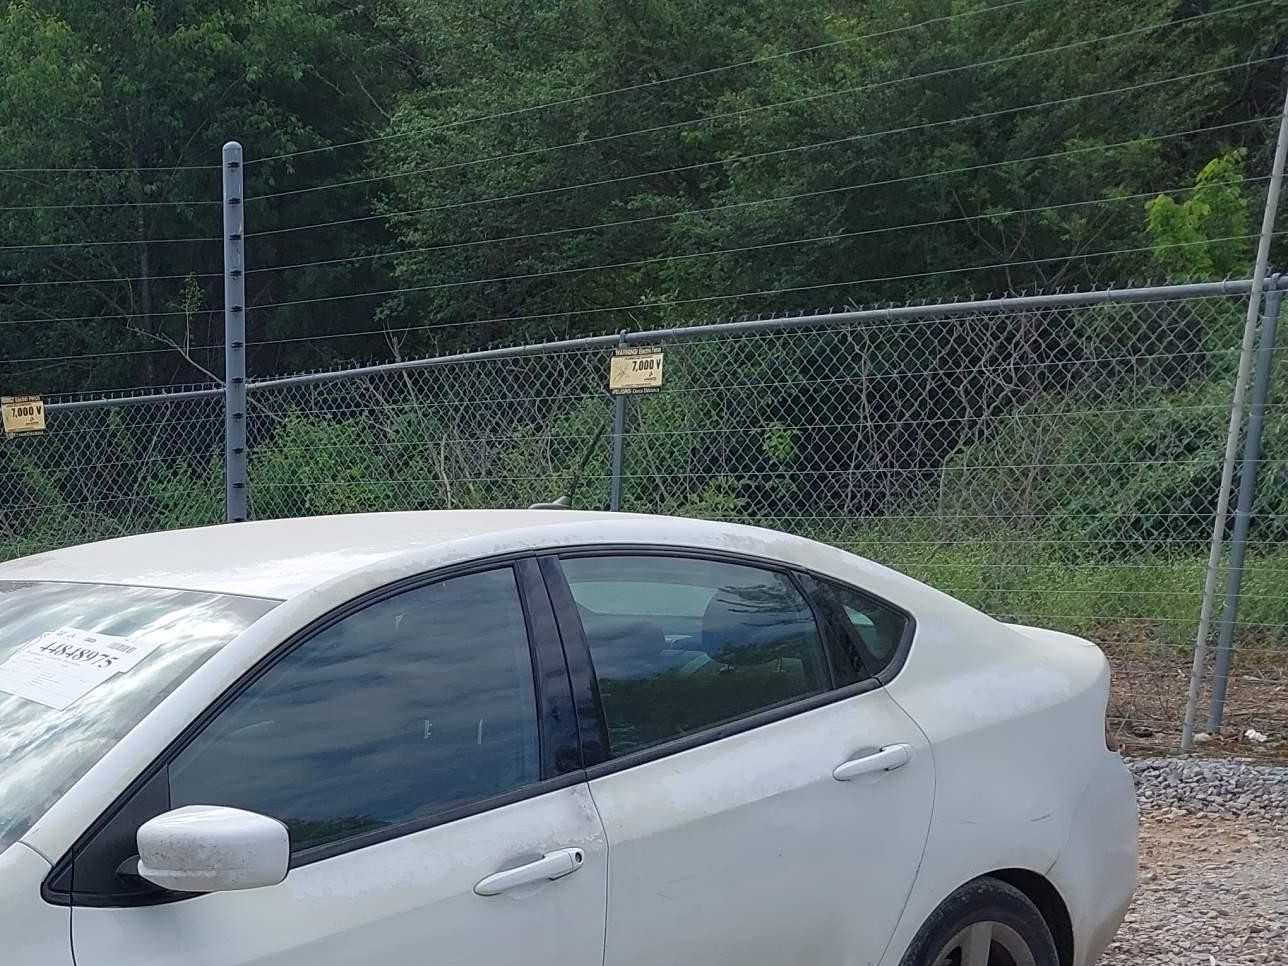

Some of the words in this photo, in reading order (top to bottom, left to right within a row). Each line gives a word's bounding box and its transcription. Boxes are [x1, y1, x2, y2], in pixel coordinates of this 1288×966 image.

[632, 359, 654, 373] 7,000
[656, 358, 662, 370] V
[36, 405, 42, 415] V
[40, 641, 120, 668] 44848975
